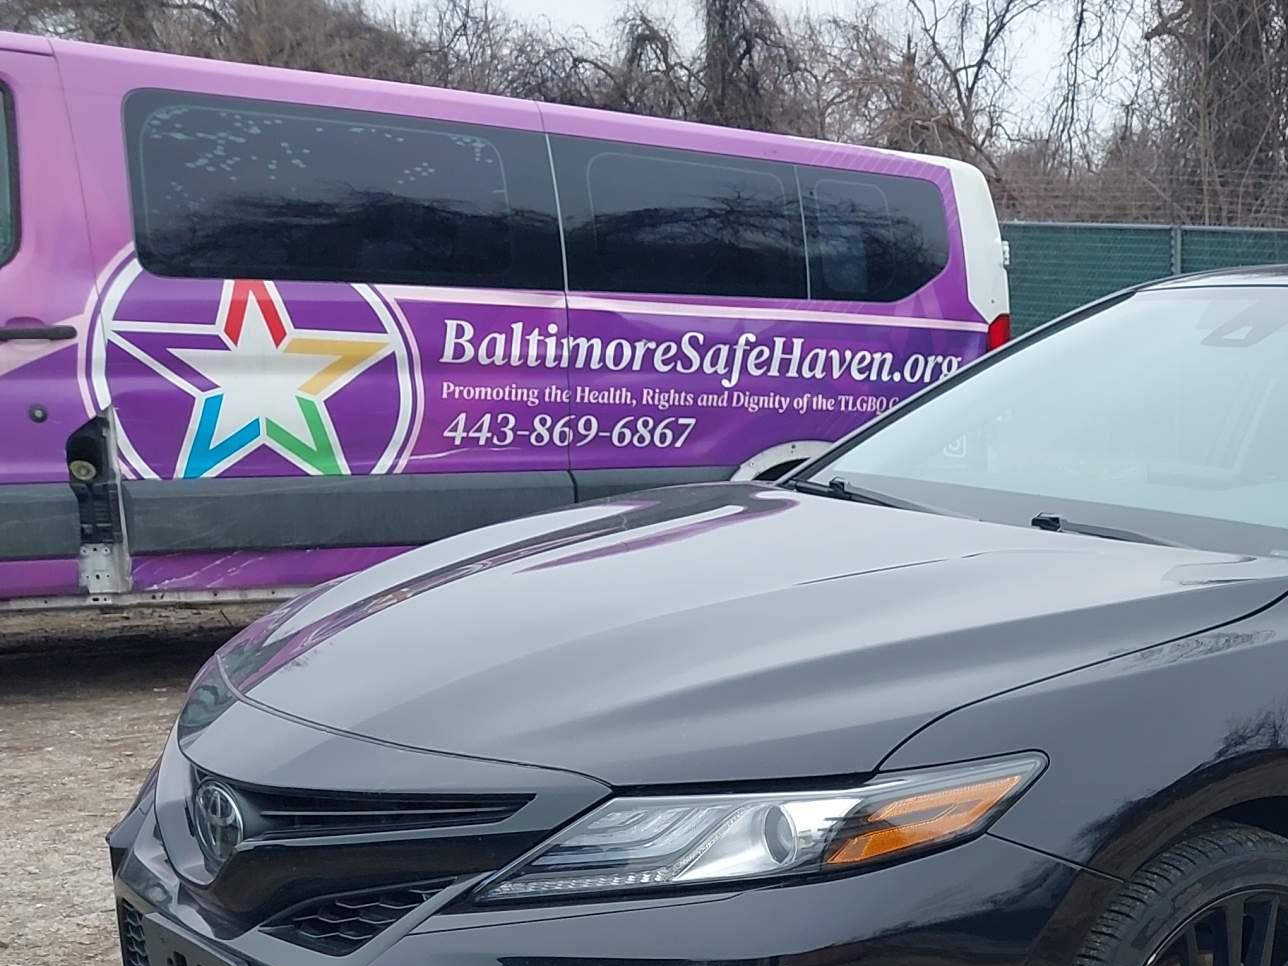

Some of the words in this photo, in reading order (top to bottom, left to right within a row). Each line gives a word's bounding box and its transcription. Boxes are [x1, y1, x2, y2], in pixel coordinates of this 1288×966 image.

[439, 318, 962, 388] BaltimoreSafeHaven.org
[441, 381, 539, 406] Promoting
[544, 385, 571, 403] the
[575, 386, 637, 407] Health,
[642, 388, 693, 410] Rights
[697, 390, 728, 407] and
[732, 391, 790, 413] Dignity
[793, 393, 811, 414] of
[812, 394, 835, 411] the
[443, 412, 696, 448] 443-869-6867
